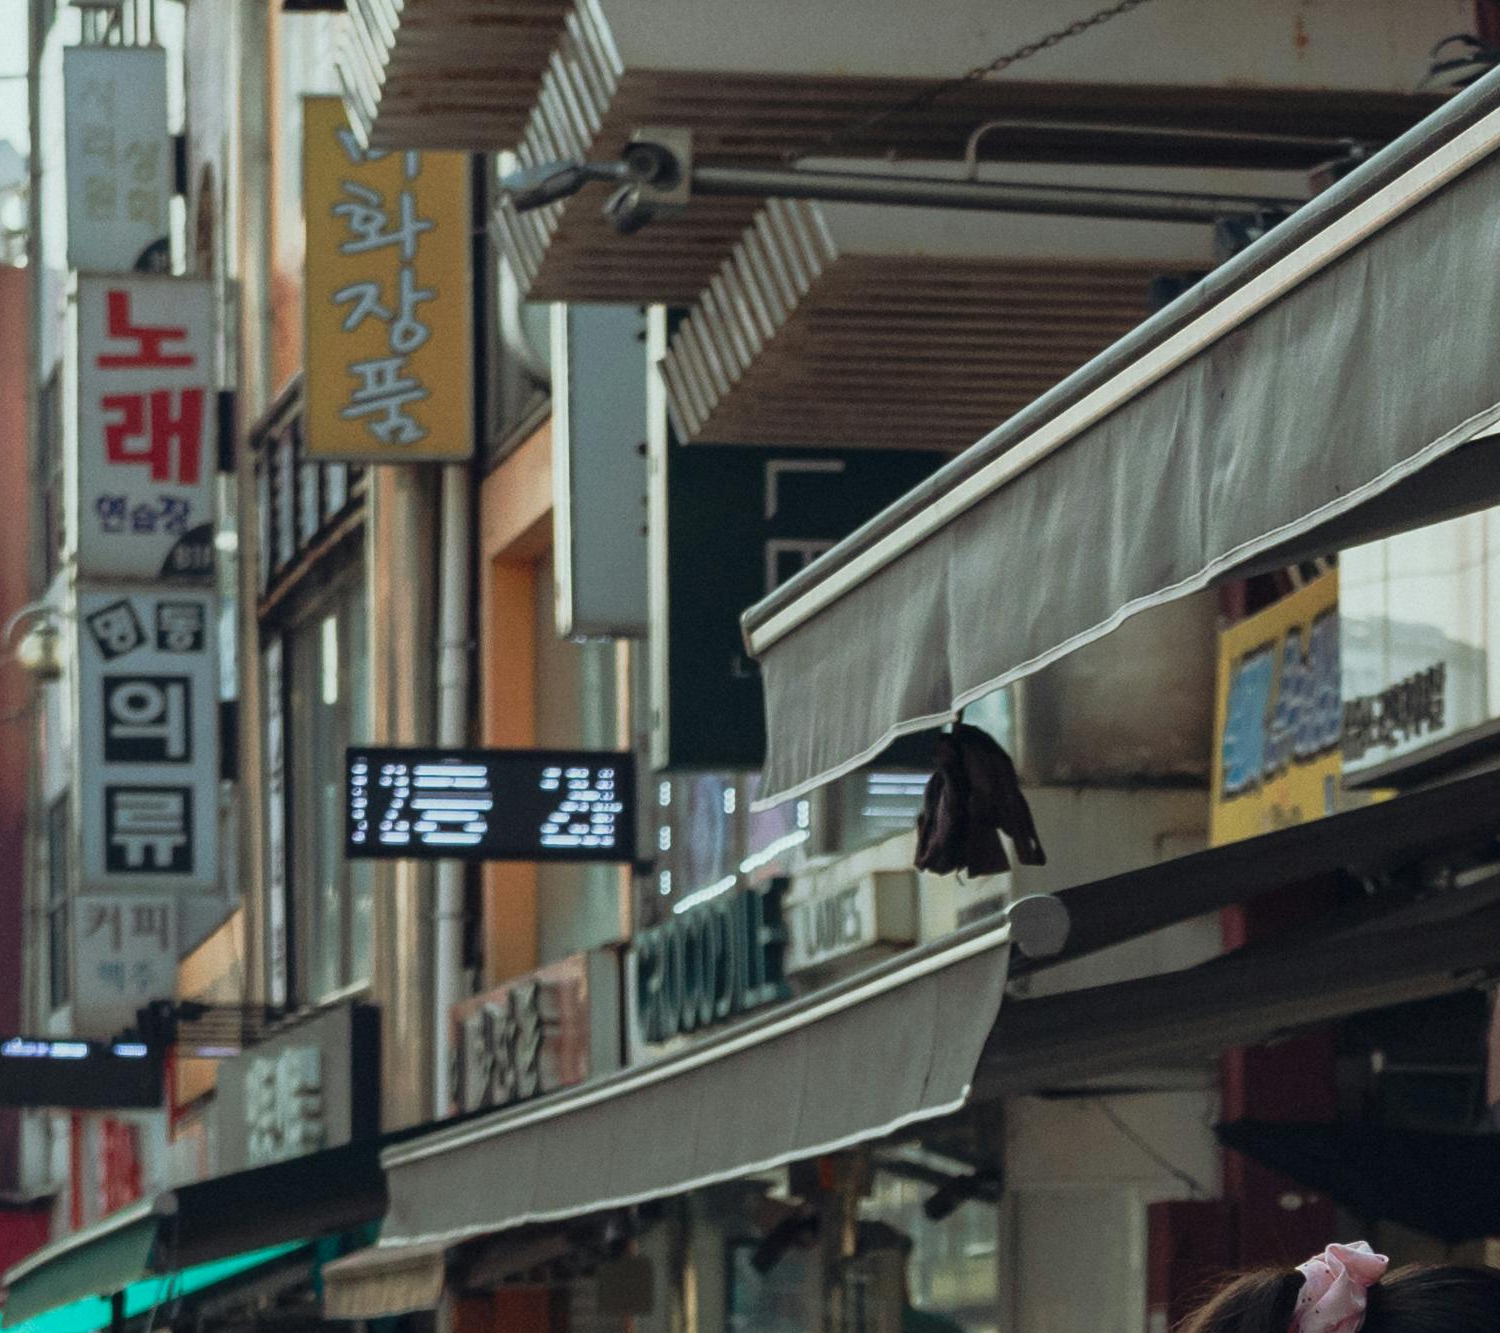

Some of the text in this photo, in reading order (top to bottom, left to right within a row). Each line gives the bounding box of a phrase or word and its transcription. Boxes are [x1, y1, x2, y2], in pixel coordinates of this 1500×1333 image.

[95, 289, 204, 484] 노래
[106, 680, 188, 870] 의류
[85, 904, 171, 953] 커피
